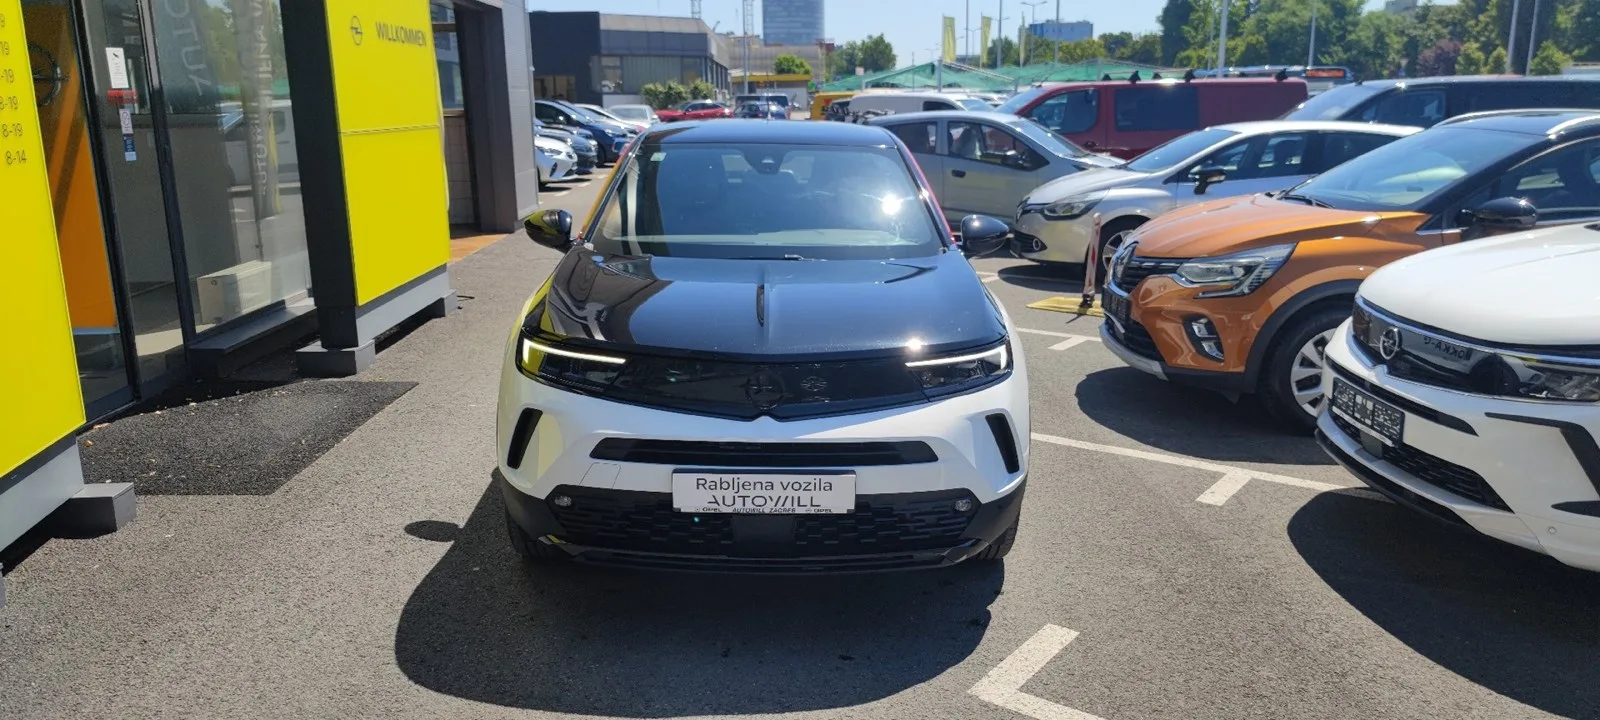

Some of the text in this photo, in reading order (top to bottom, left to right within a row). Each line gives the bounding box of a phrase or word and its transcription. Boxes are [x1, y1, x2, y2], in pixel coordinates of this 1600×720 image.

[375, 21, 427, 47] WILLKOMMEN
[2, 122, 23, 138] 8-19
[5, 149, 27, 165] 8-14
[696, 477, 833, 493] Rabljena vozila
[707, 495, 821, 508] AUTOWILL
